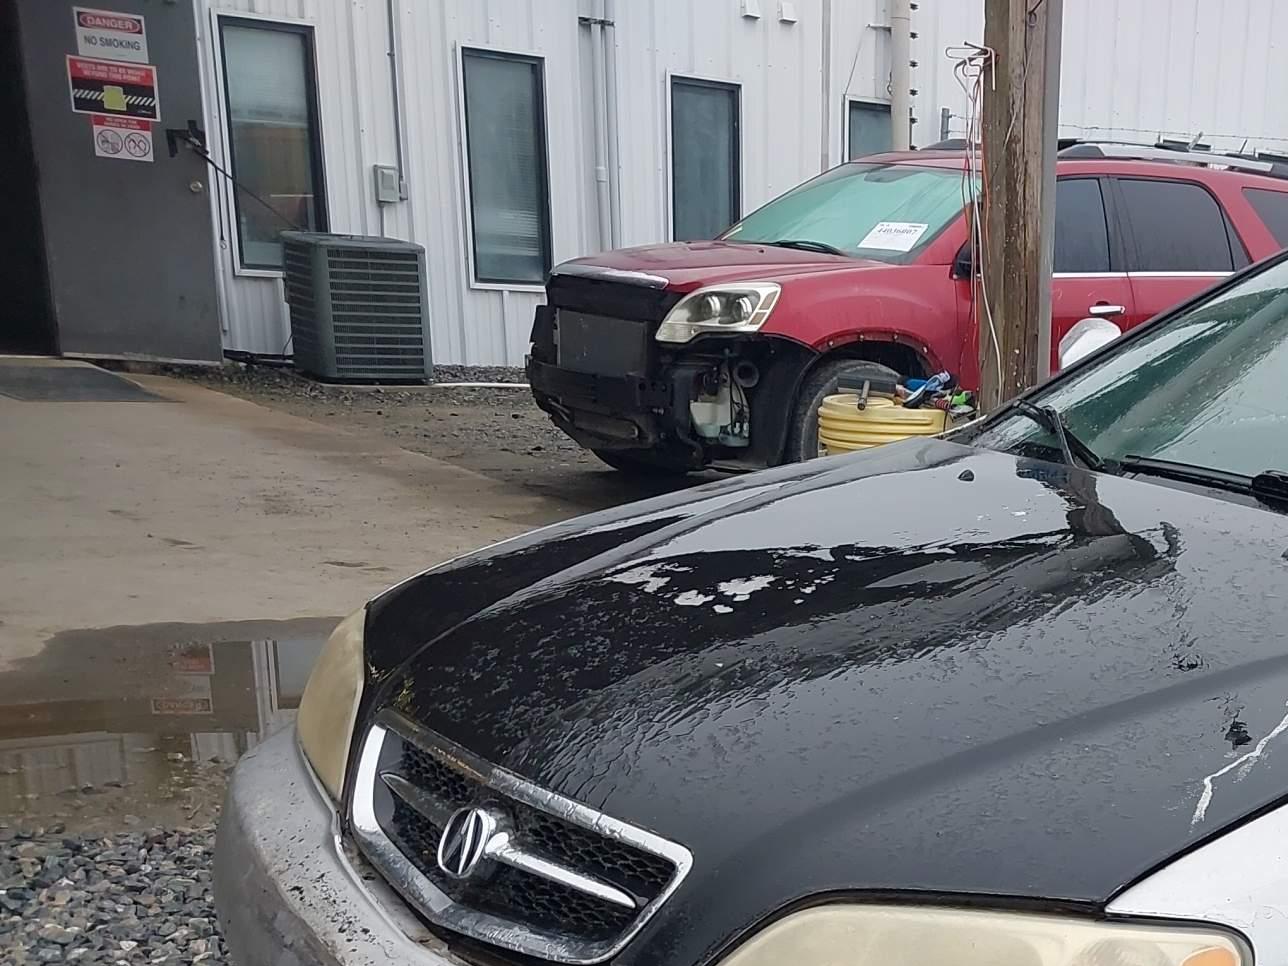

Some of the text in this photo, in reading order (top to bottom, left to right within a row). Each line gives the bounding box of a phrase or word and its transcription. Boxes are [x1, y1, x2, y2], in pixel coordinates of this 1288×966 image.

[86, 16, 133, 30] DANGER
[84, 35, 141, 51] NO SMOKING
